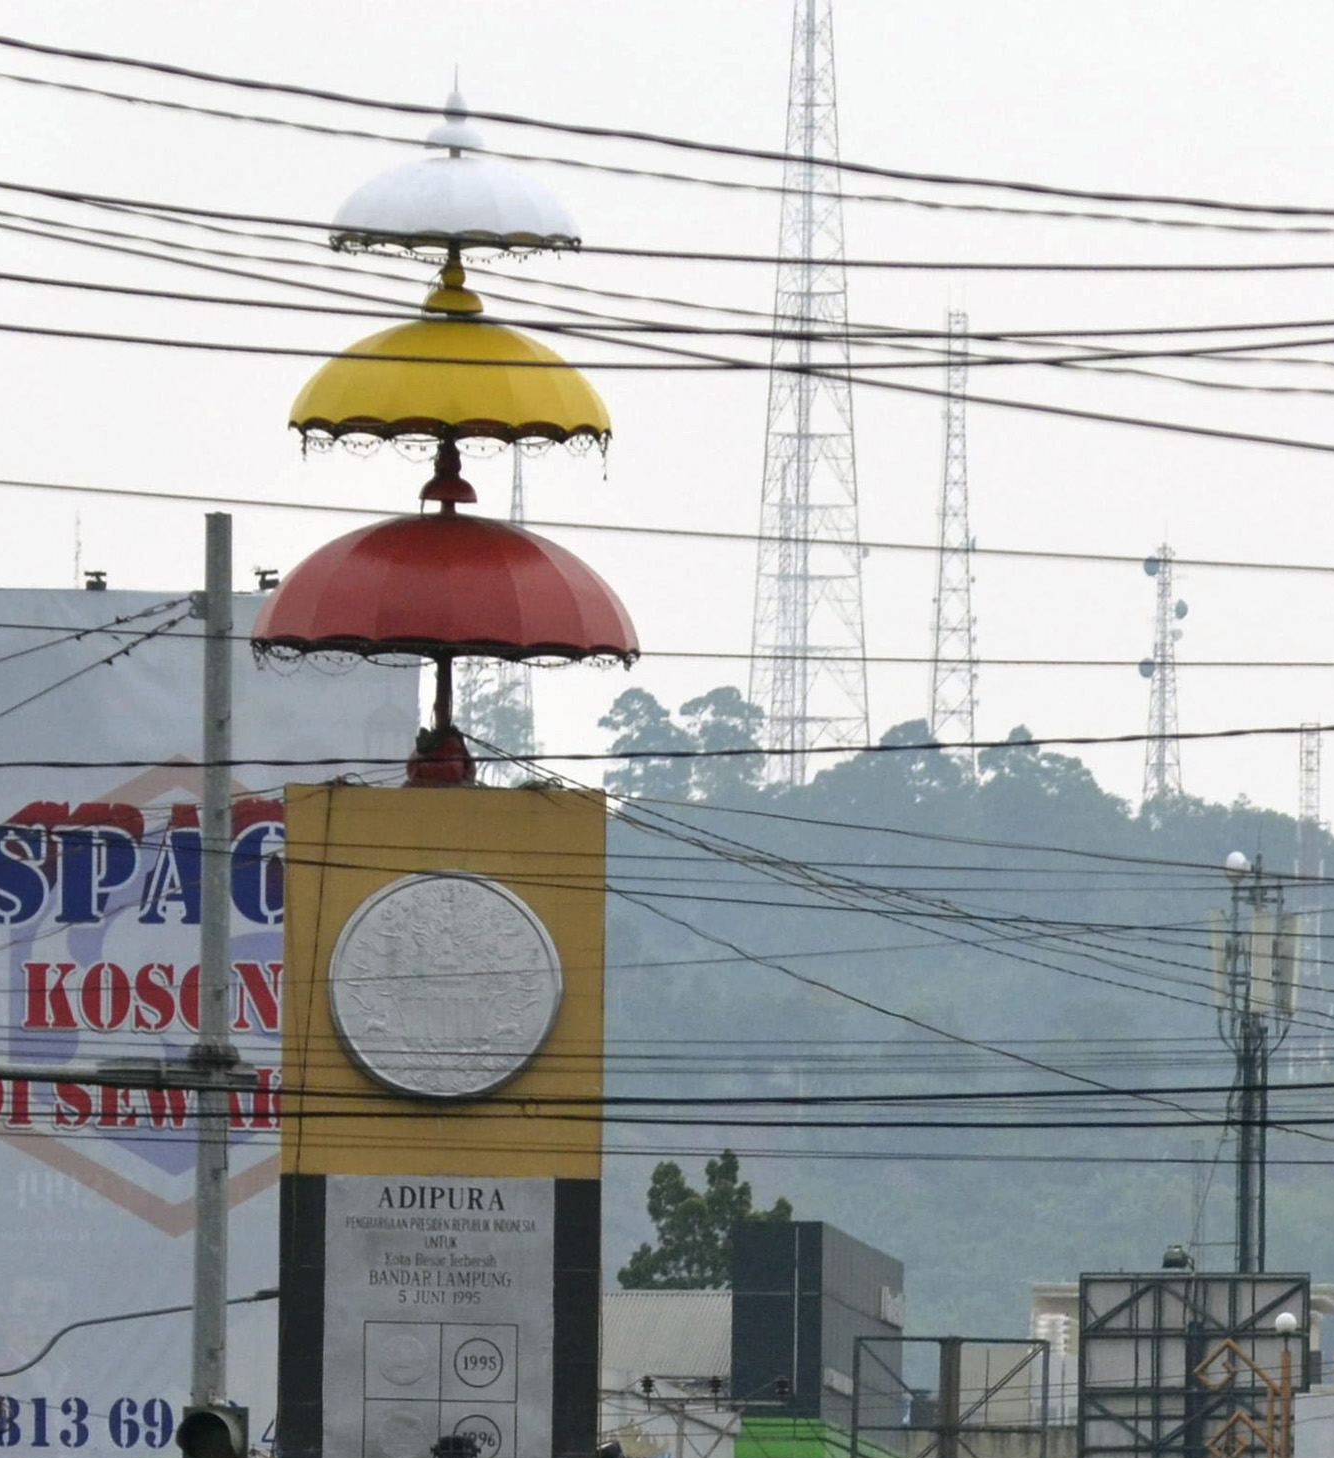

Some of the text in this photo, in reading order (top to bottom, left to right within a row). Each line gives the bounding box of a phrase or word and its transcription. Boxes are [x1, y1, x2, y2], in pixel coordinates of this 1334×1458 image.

[378, 1186, 507, 1212] ADIPURA
[424, 1235, 457, 1250] UNTUK
[385, 1253, 412, 1266] Kota
[369, 1270, 512, 1288] BANDAR LAMPUNG
[398, 1290, 482, 1304] 5 JUNI 1995
[462, 1355, 498, 1372] 1995
